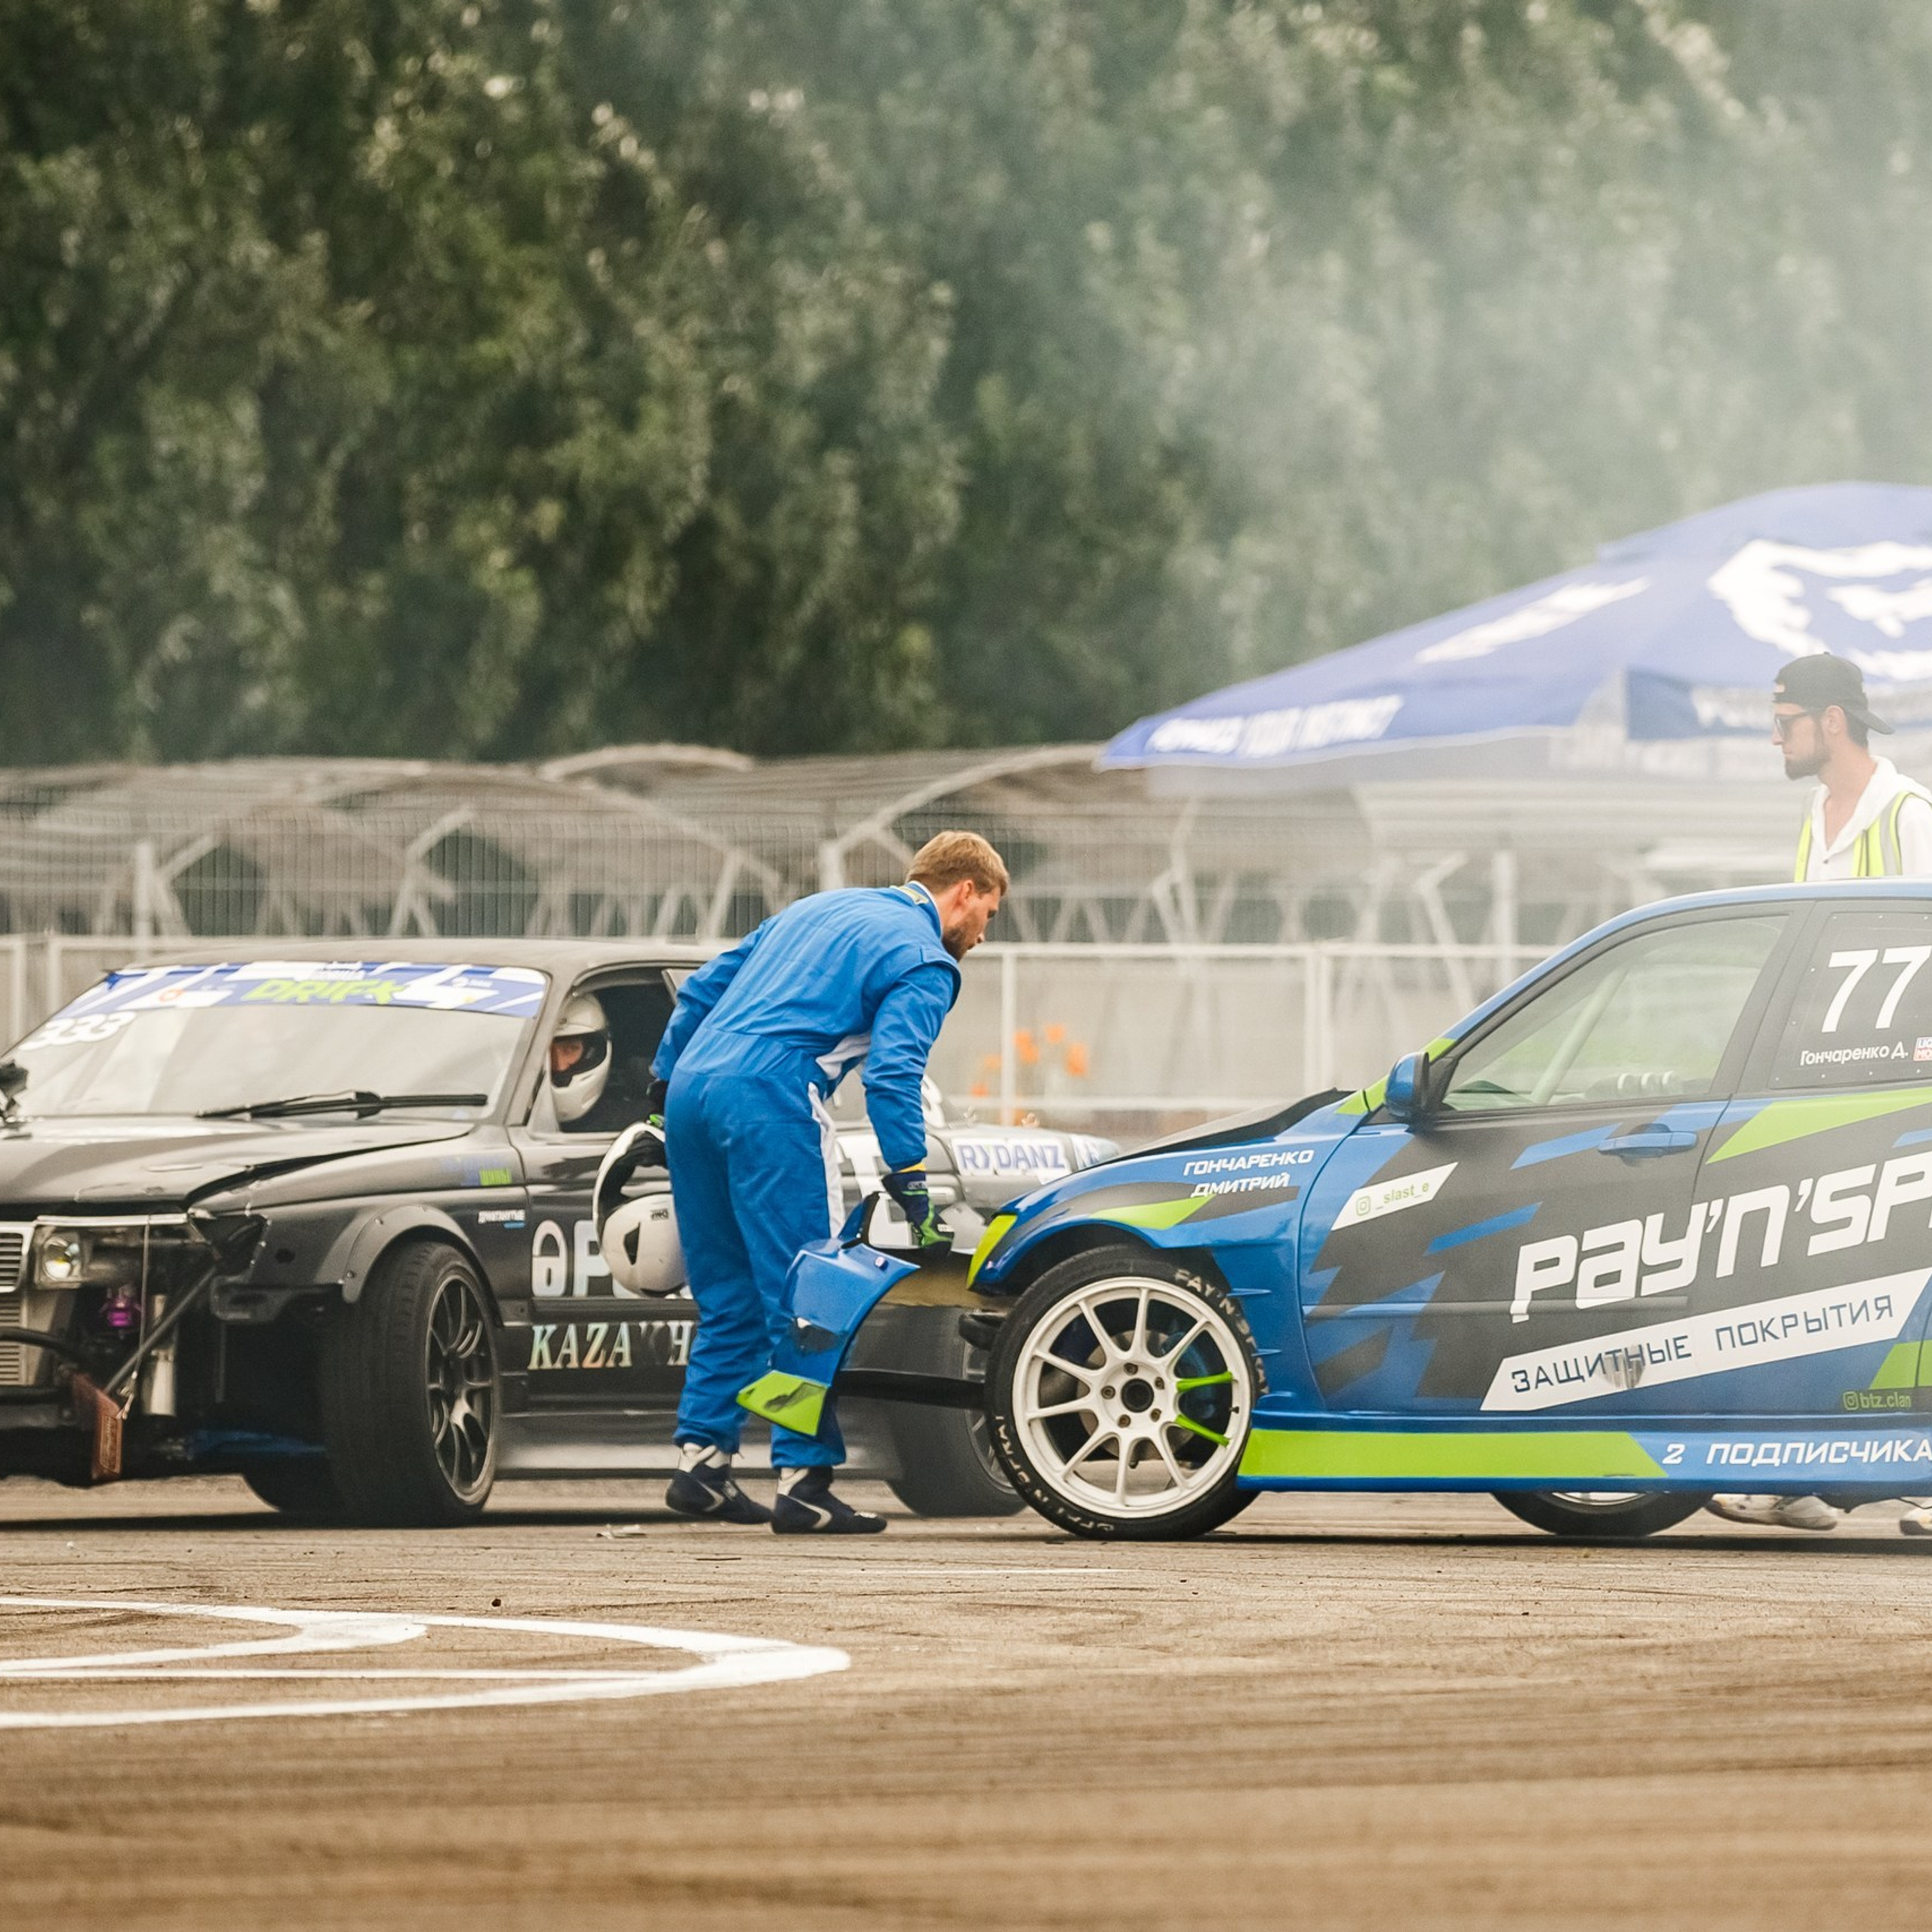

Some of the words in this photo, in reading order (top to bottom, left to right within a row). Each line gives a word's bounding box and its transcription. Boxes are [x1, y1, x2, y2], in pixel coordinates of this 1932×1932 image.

[1821, 945, 1932, 1033] 77
[1799, 1045, 1890, 1066] Гончаренко
[1890, 1041, 1909, 1060] Д.
[1183, 1149, 1315, 1176] ГОНЧАРЕНКО
[1190, 1172, 1291, 1198] ДМИТРИЙ
[1511, 1334, 1692, 1393] ЗАЩИТНЫЕ
[1715, 1294, 1894, 1351] ПОКРЫТИЯ
[1858, 1392, 1912, 1410] btz.clan
[1662, 1444, 1686, 1465] 2
[1706, 1438, 1932, 1467] ПОДПИСЧИКА
